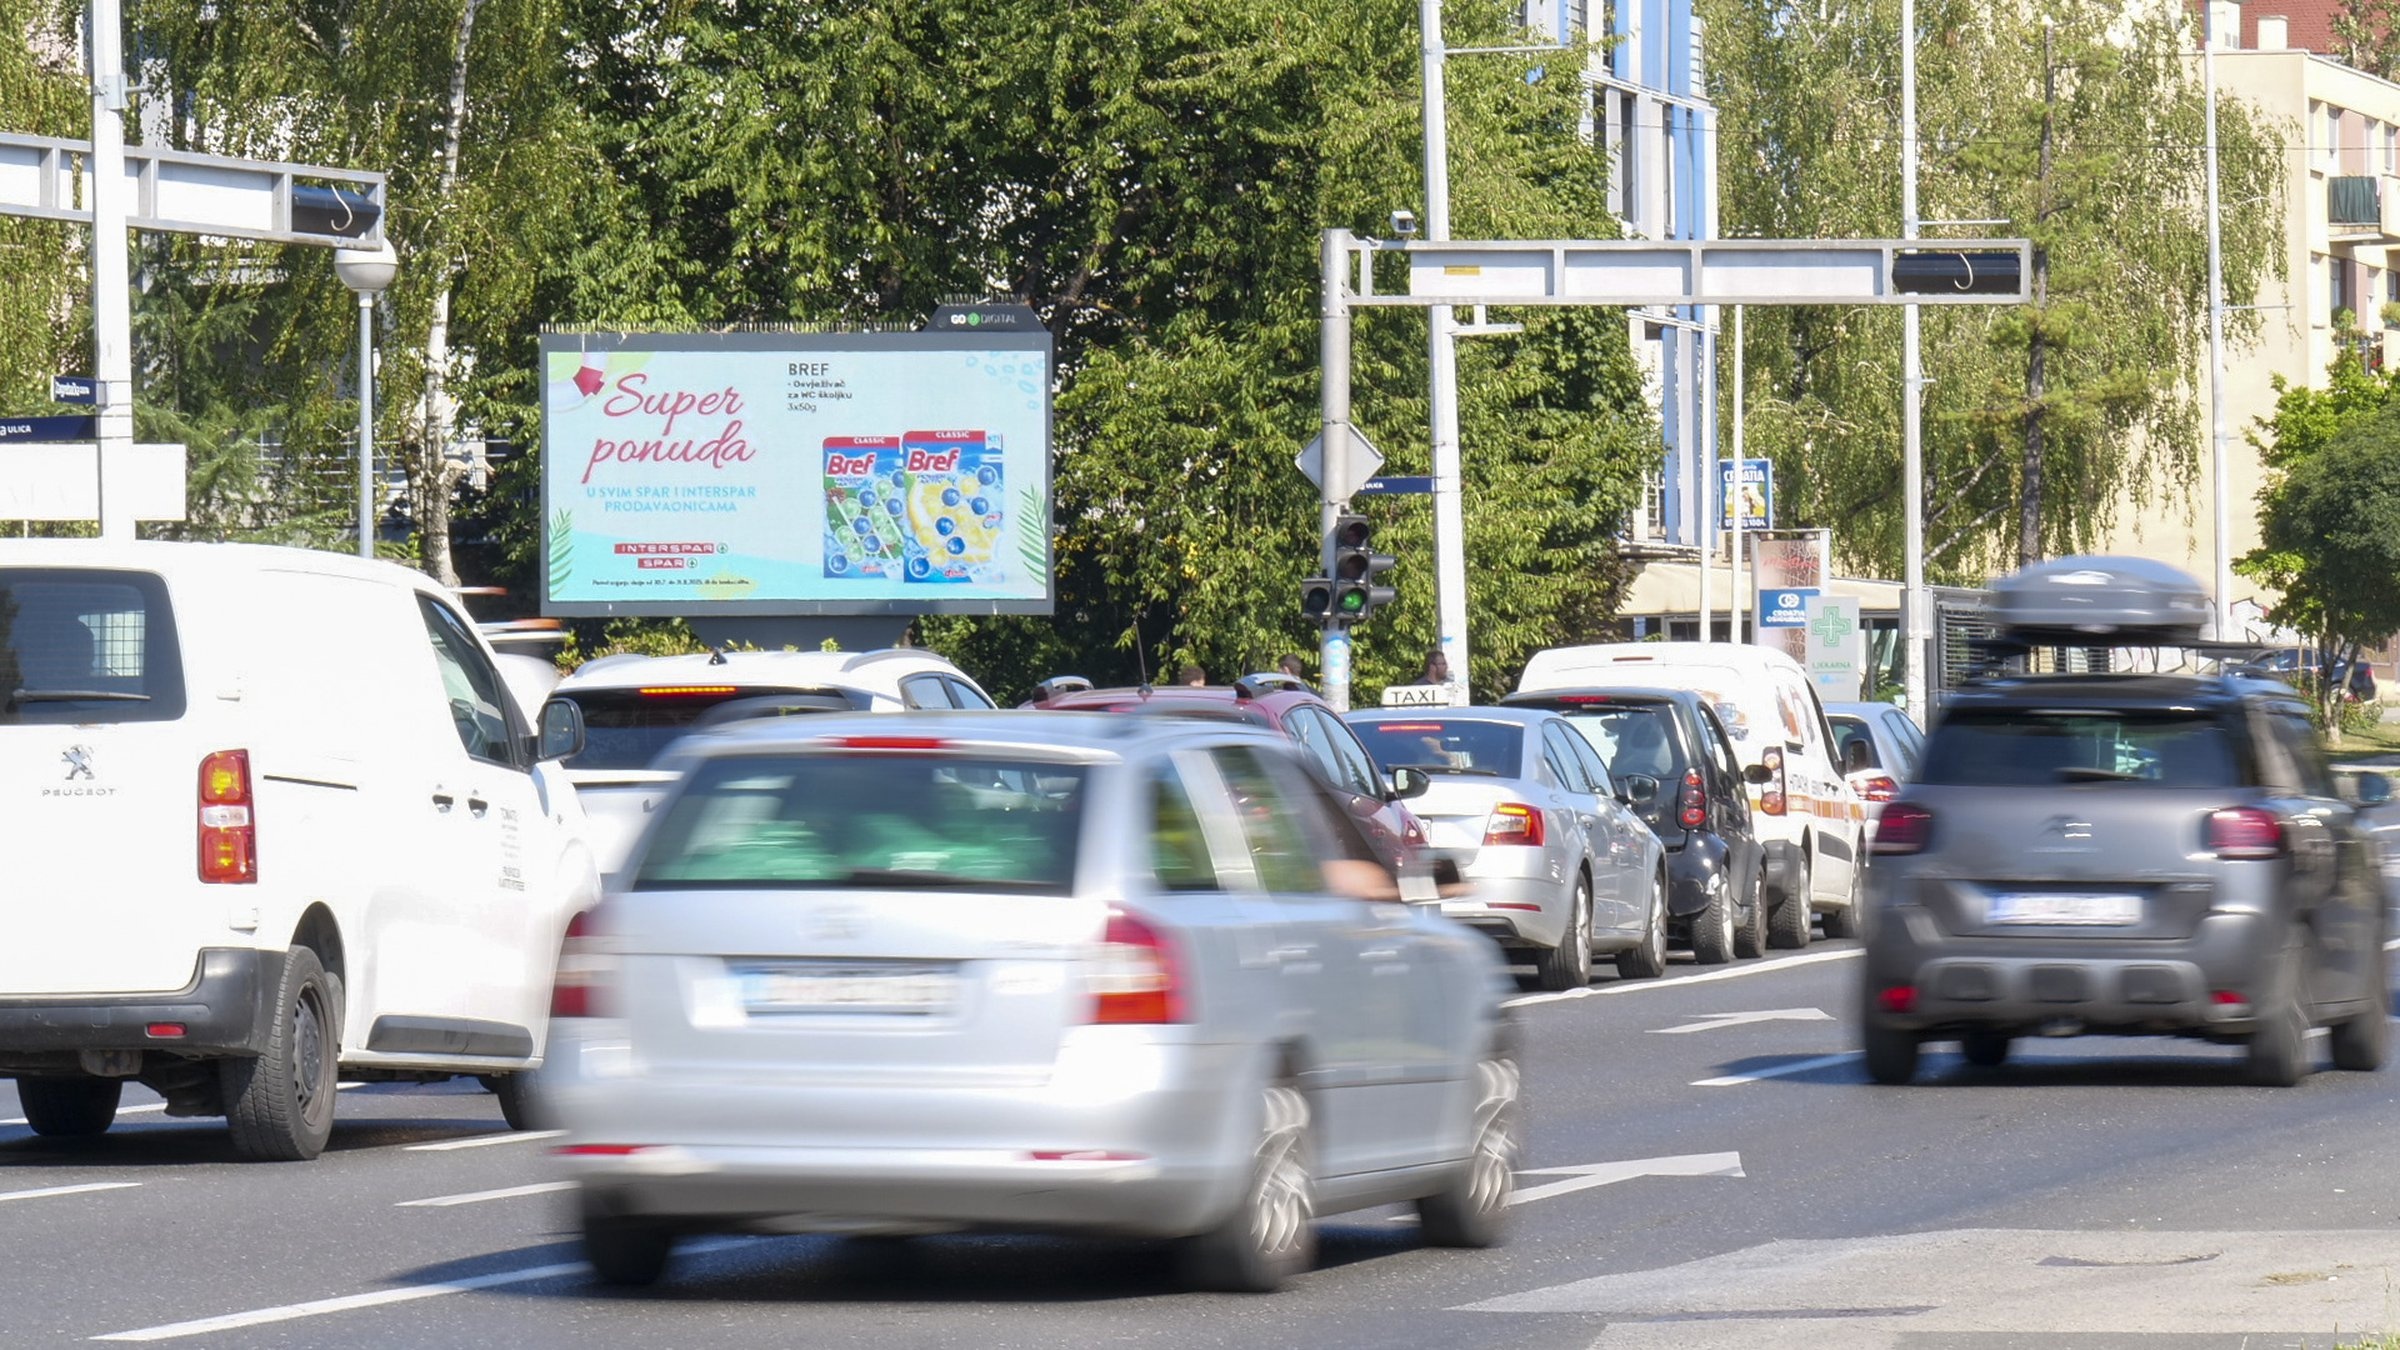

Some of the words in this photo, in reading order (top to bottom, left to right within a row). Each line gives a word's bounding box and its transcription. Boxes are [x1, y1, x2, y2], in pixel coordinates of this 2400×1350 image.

[951, 314, 966, 325] GO
[981, 314, 1016, 324] DIGITAL
[788, 363, 829, 376] BREF
[801, 391, 816, 399] WC
[819, 391, 853, 400] školjku
[603, 373, 744, 436] Super
[7, 425, 32, 434] ULICA
[935, 431, 970, 439] CLASSIC
[853, 437, 886, 445] CLASSIC
[581, 420, 756, 484] ponuda
[827, 453, 876, 476] Bref
[907, 448, 961, 472] Bref
[586, 486, 595, 498] U
[600, 486, 632, 498] SVIM
[636, 486, 671, 498] SPAR
[682, 485, 756, 498] INTERSPAR
[605, 501, 737, 513] PRODAVAONICAMA
[622, 544, 714, 553] INTERSPAR
[643, 558, 684, 568] SPAR
[1391, 689, 1436, 703] TAXI
[42, 788, 116, 797] PEUGEOT
